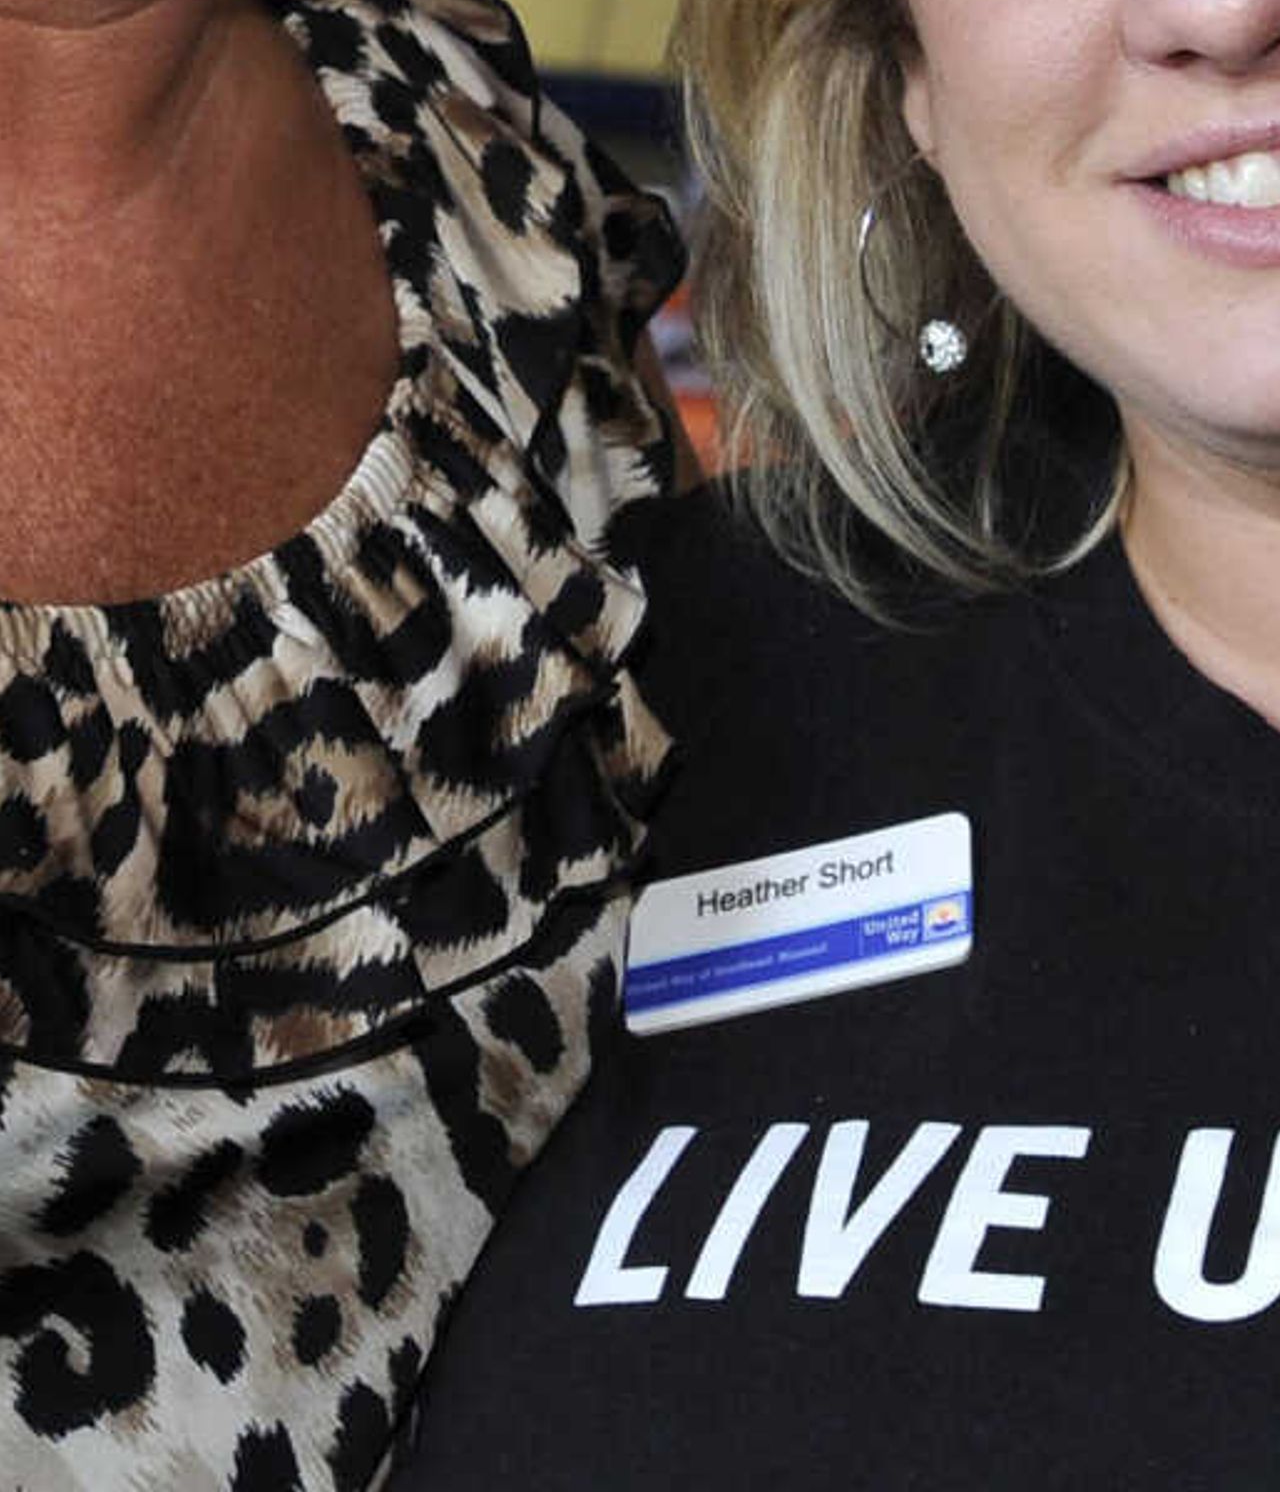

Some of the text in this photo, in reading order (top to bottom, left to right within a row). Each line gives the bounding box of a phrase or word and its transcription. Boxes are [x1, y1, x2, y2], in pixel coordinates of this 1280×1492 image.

[695, 849, 895, 917] Heather Short
[862, 909, 920, 938] United
[886, 926, 920, 946] Way
[574, 1119, 1092, 1311] LIVE
